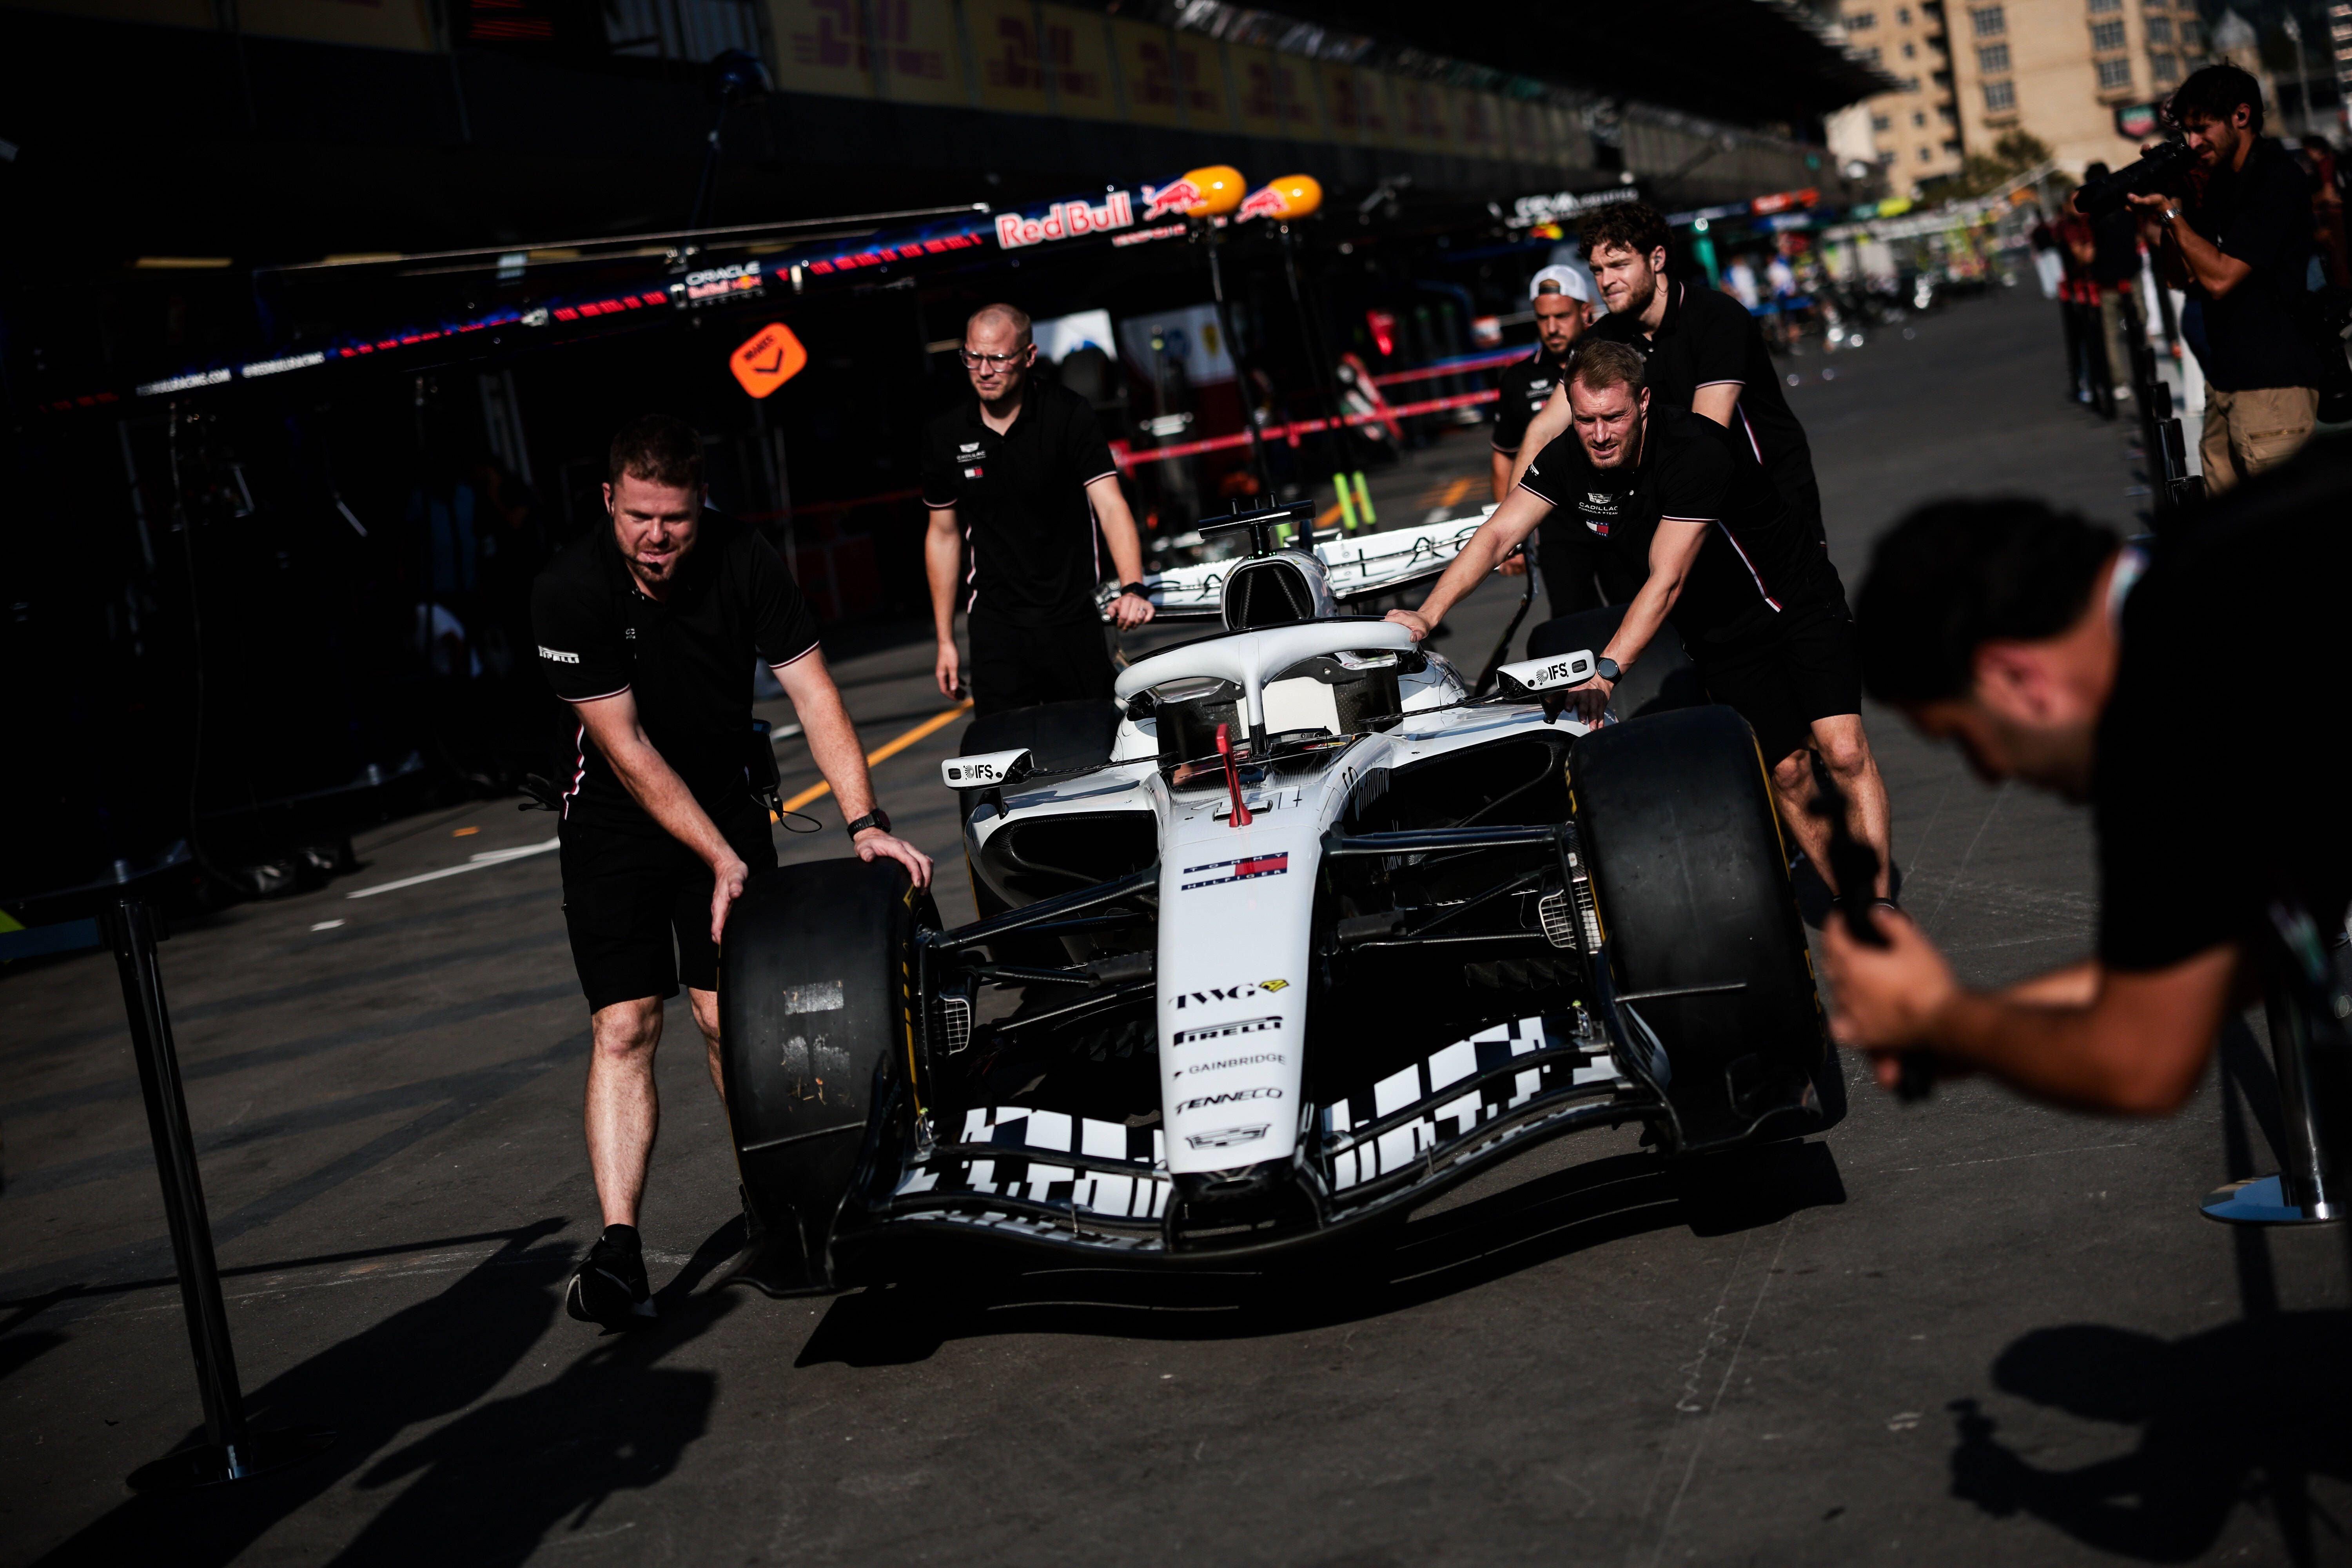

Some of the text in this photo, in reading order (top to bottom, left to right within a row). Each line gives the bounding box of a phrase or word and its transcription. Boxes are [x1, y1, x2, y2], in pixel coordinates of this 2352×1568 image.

[996, 202, 1063, 249] Red
[1067, 191, 1133, 236] Bull
[686, 260, 760, 285] ORACLE
[1579, 502, 1618, 511] CADILLAC
[537, 645, 580, 664] PIRELLI
[1548, 662, 1568, 681] IFS
[975, 764, 993, 779] IFS
[1189, 853, 1283, 872] TOMMY
[1187, 869, 1281, 889] HILFIGER
[1174, 1016, 1283, 1046] PIRELLI
[1189, 1053, 1287, 1074] GAINBRIDGE
[1176, 1088, 1282, 1114] TENNECO
